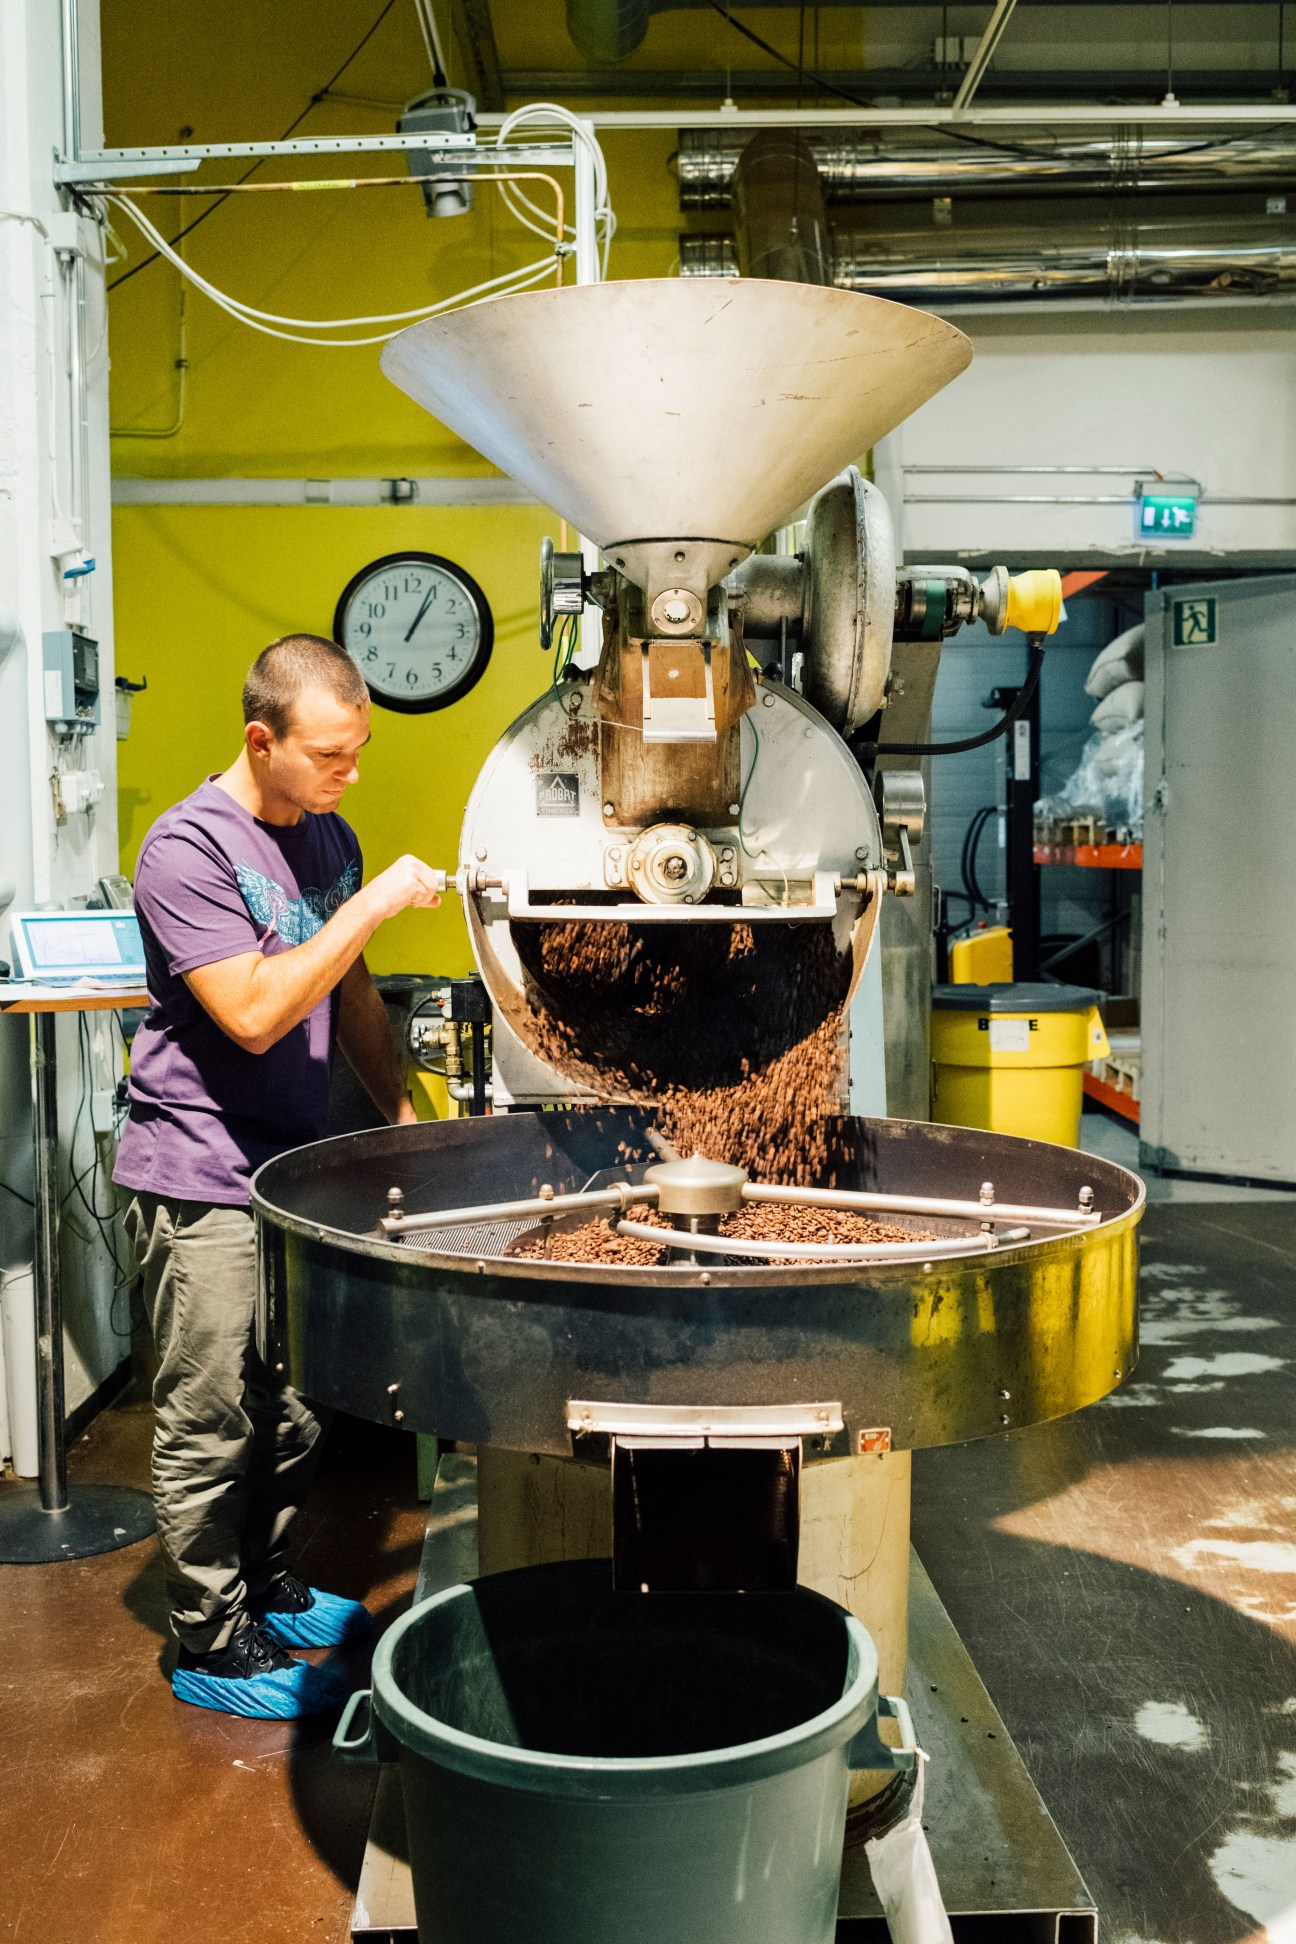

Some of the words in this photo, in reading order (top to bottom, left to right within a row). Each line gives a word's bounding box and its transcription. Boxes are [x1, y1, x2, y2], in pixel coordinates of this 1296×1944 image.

[384, 585, 398, 600] 11
[404, 578, 422, 594] 12
[368, 603, 385, 619] 10
[446, 600, 456, 614] 2
[360, 622, 372, 638] 9
[456, 623, 466, 639] 3
[366, 646, 378, 662] 8
[446, 646, 457, 660] 4
[386, 662, 396, 678] 7
[406, 668, 418, 685] 6
[432, 662, 442, 678] 5
[538, 788, 576, 800] PROBAT
